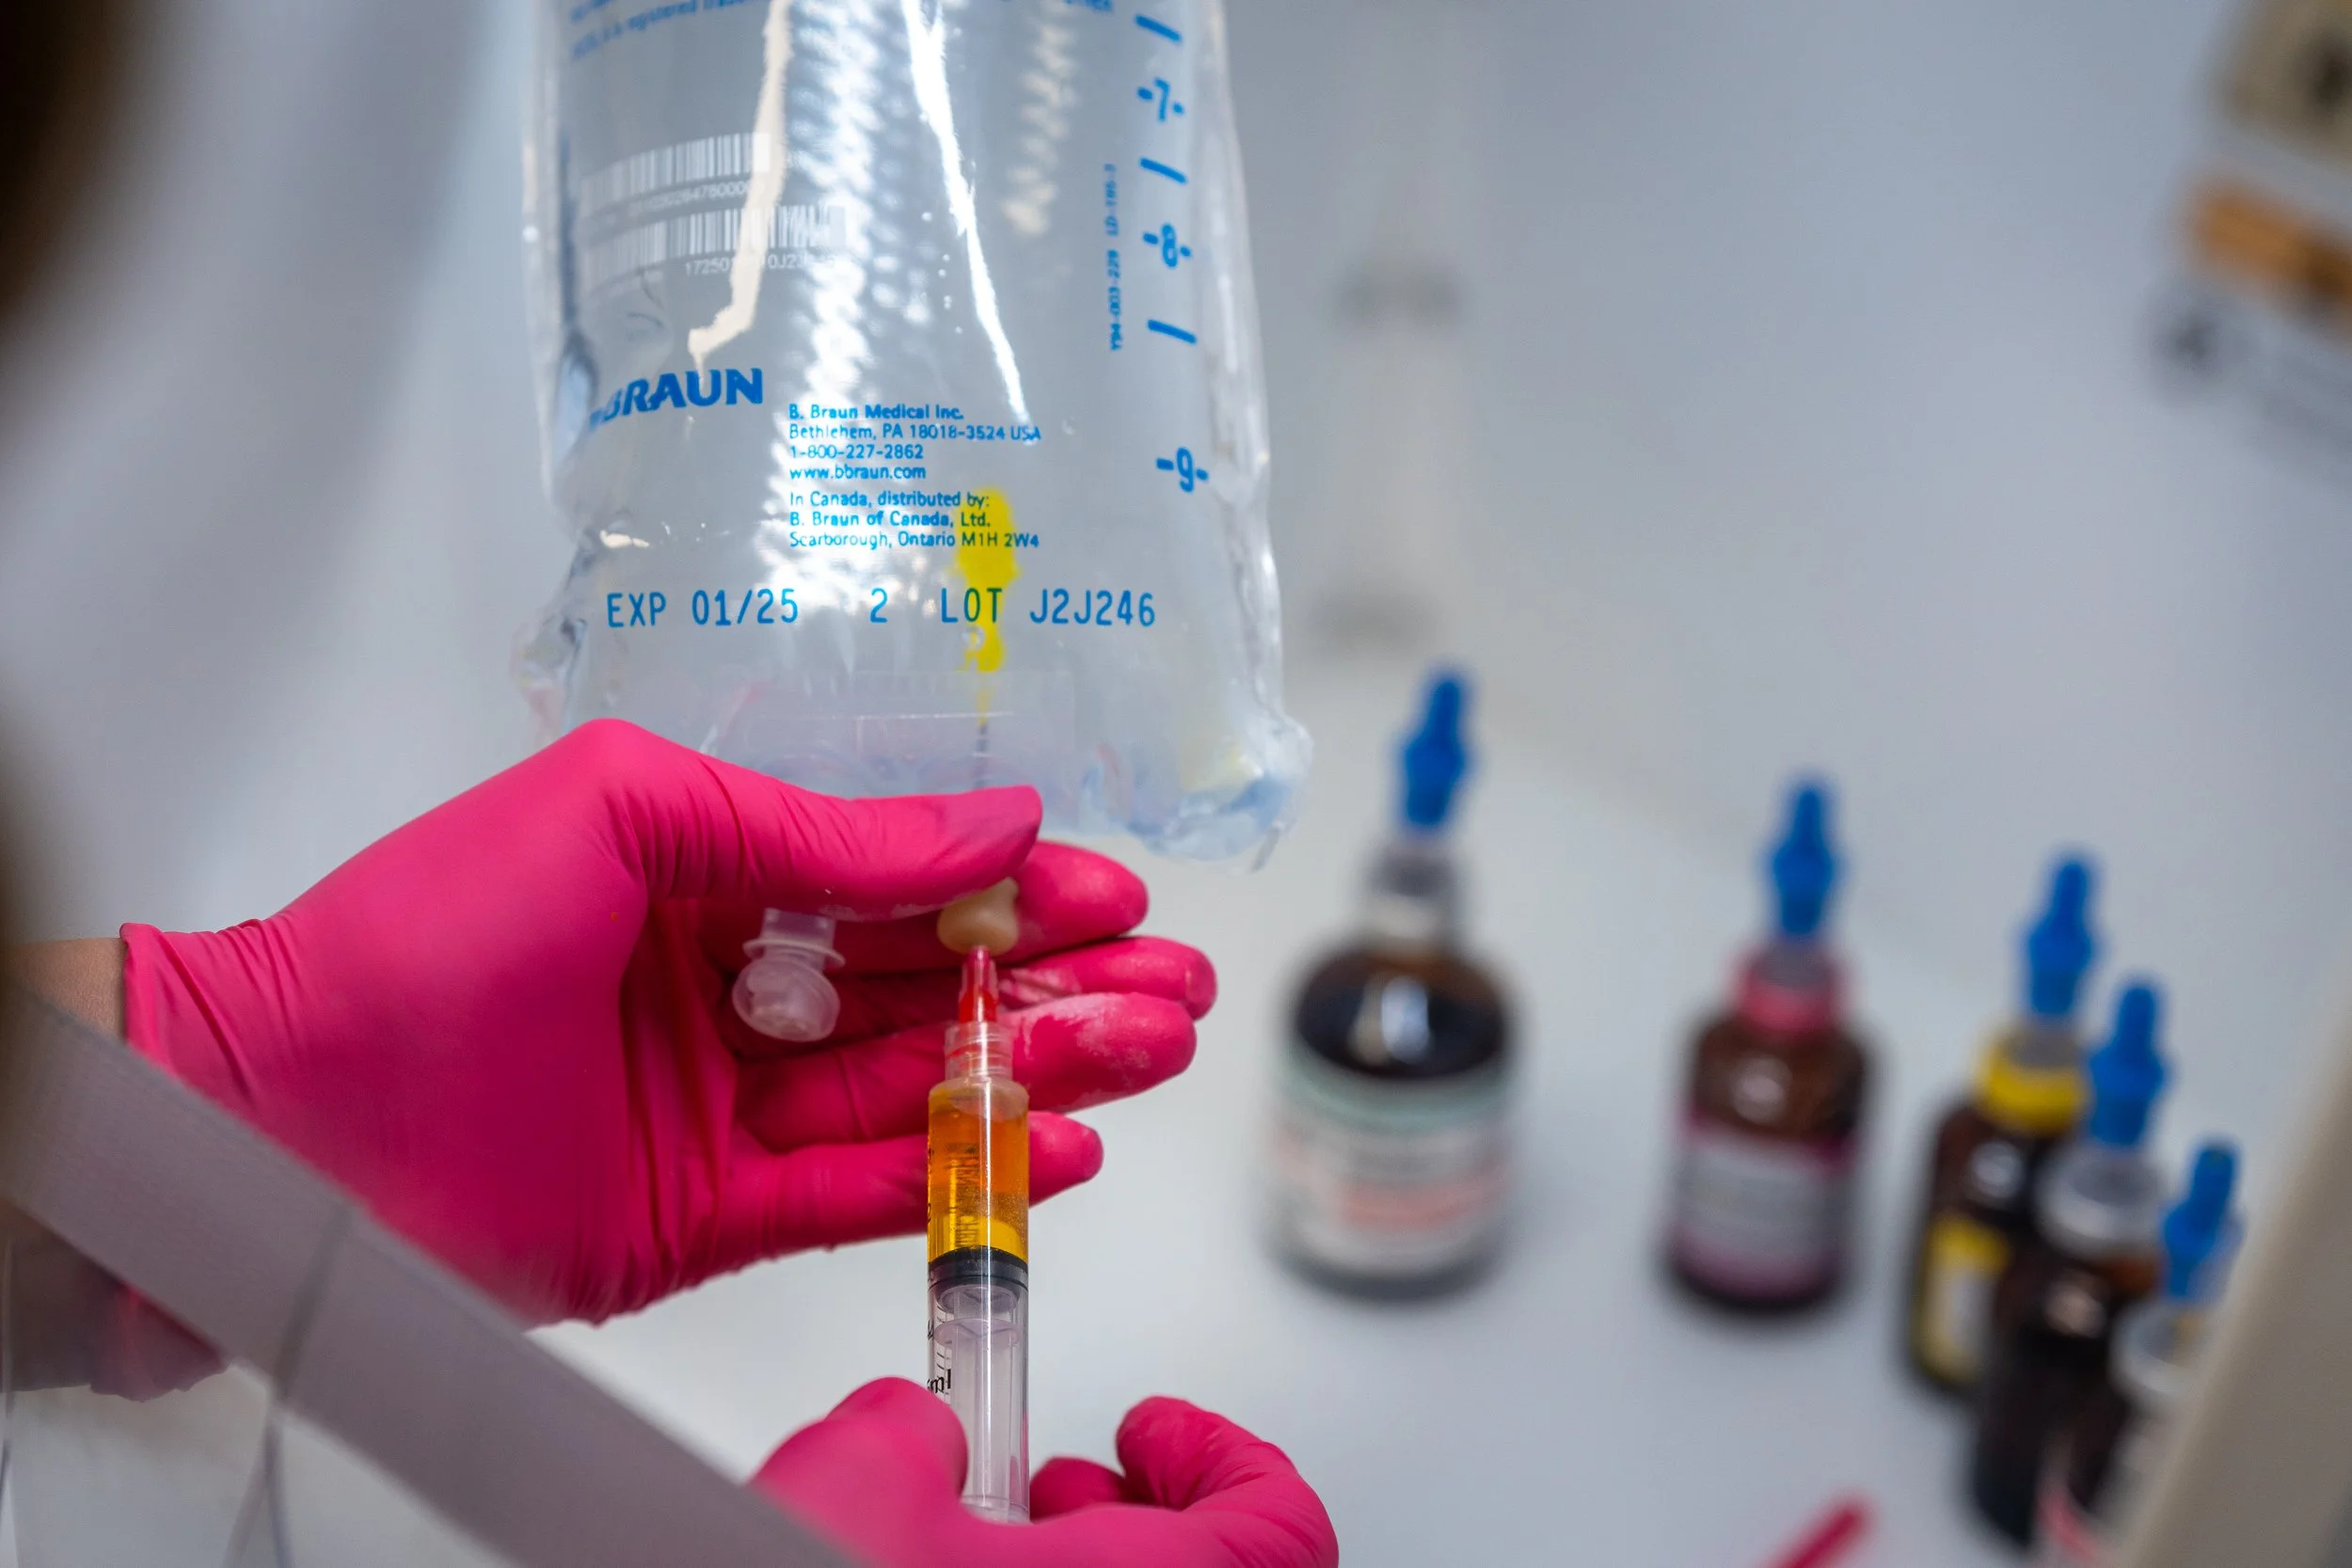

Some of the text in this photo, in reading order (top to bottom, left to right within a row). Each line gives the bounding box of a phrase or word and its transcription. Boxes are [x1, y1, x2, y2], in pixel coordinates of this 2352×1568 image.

[788, 403, 964, 420] B. Braun Medical Inc.
[789, 422, 1041, 441] Bethlehem, PA 18018-3524 USA
[790, 443, 924, 460] 1-800-227-2862
[789, 463, 926, 480] www.bbraun.com
[790, 490, 990, 510] In Canada, distributed by:
[789, 510, 991, 529] B. Braun of Canada, Ltd.
[789, 530, 1040, 550] Scarborough, Ontario M1H 2W4
[607, 587, 1155, 628] EXP 01/25 2 LOT J2J246
